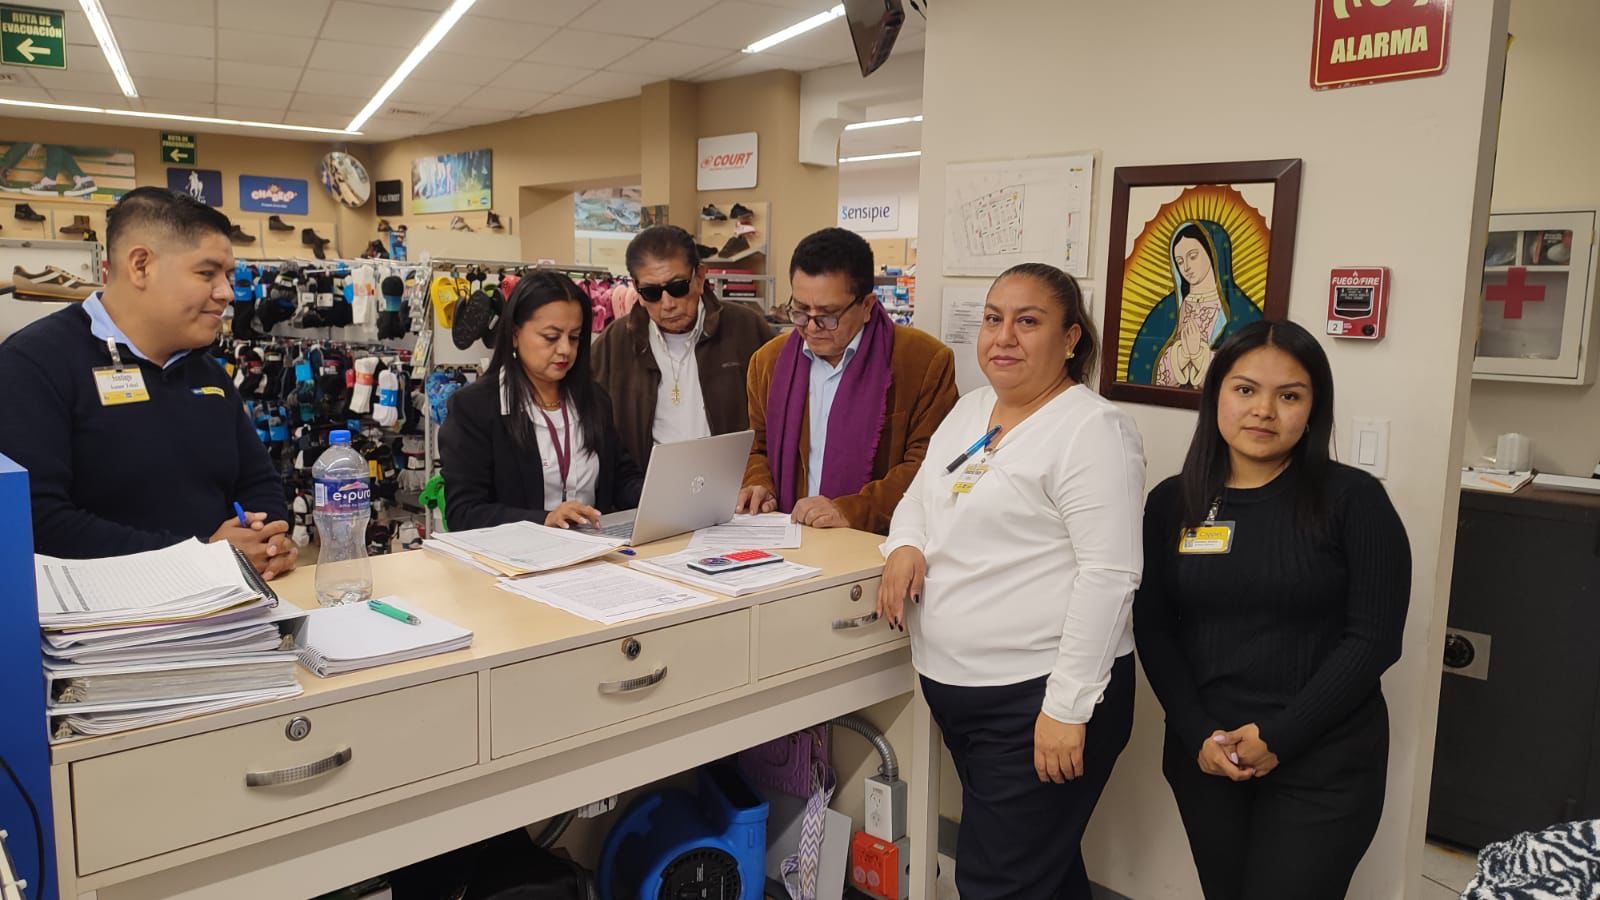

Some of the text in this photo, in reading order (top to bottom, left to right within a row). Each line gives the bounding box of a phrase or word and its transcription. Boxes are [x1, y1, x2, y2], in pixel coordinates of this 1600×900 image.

[12, 12, 51, 26] RUTA DE
[2, 22, 62, 38] EVACUACIÓN
[1330, 25, 1428, 64] ALARMA
[713, 152, 753, 167] COURT
[1332, 323, 1338, 331] 2
